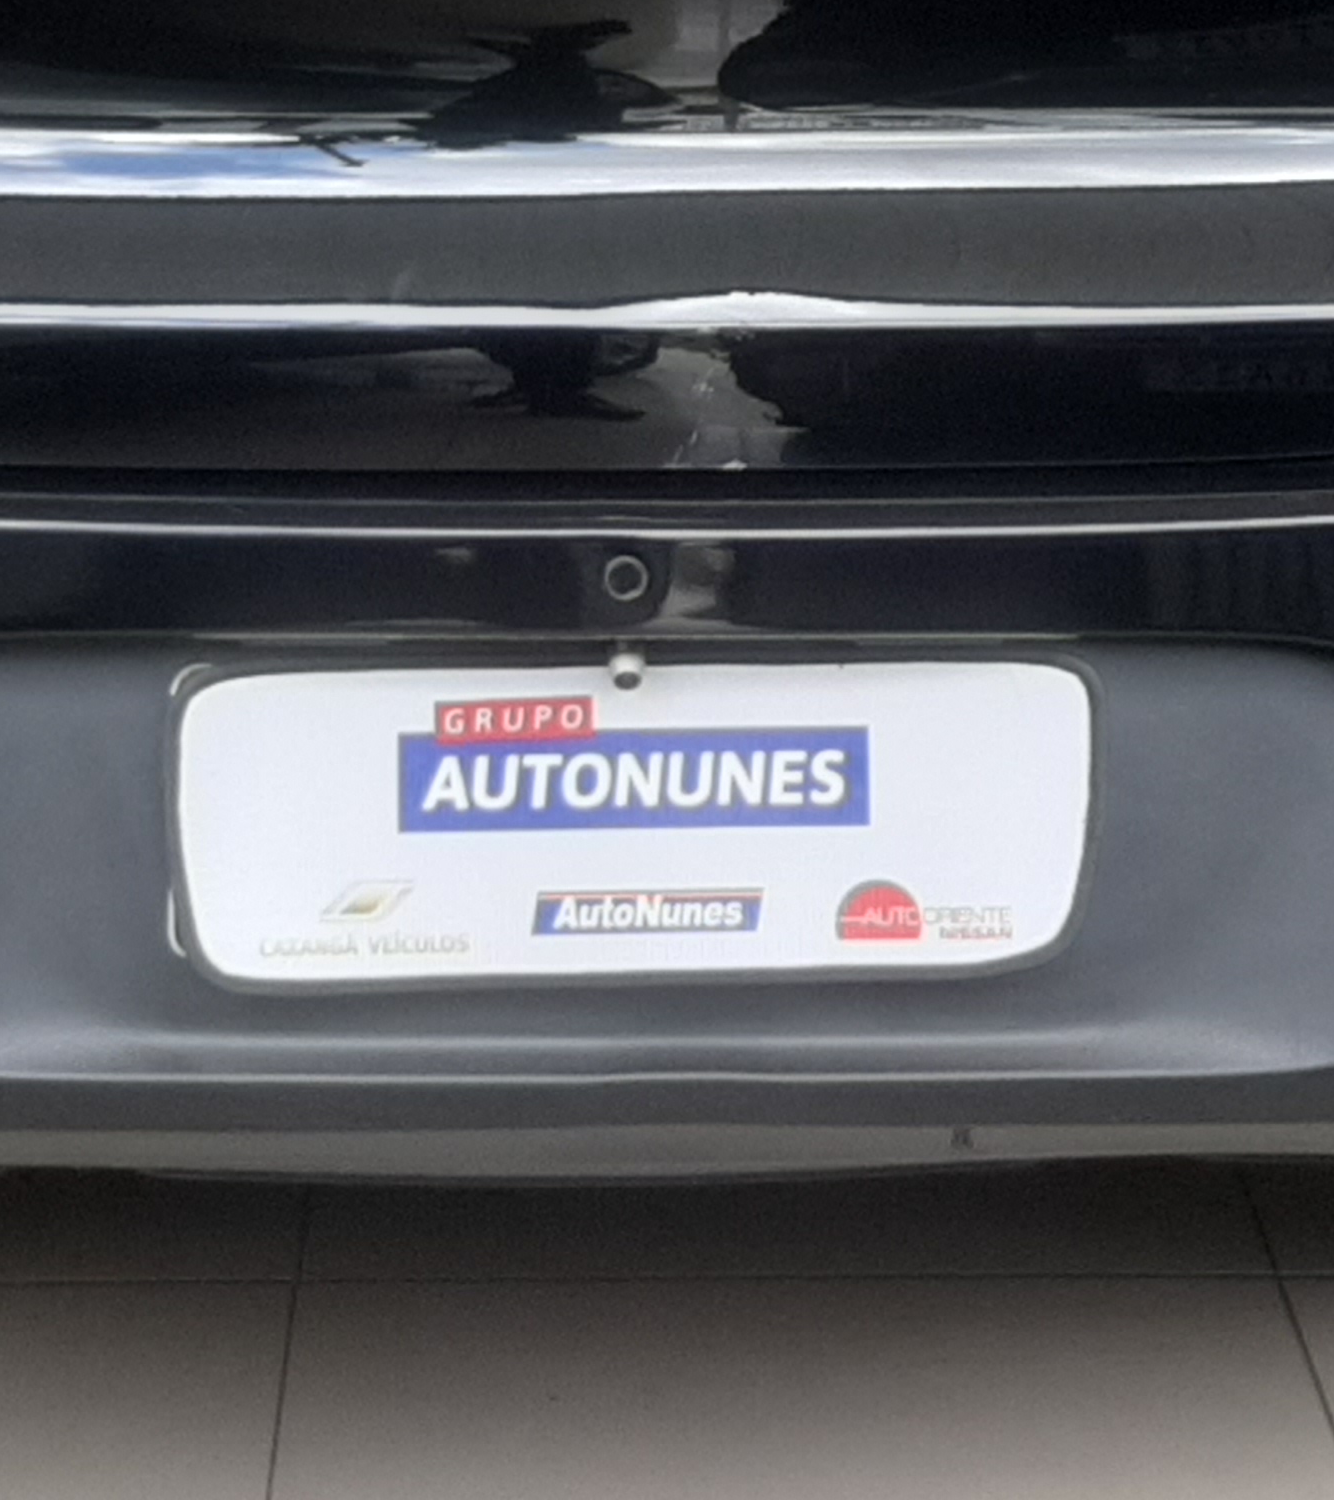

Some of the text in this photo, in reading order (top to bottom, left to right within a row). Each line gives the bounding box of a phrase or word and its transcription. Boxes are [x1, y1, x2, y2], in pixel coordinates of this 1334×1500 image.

[442, 702, 585, 736] GRUPO
[421, 749, 847, 813] AUTONUNES
[552, 894, 745, 931] AutoNunes
